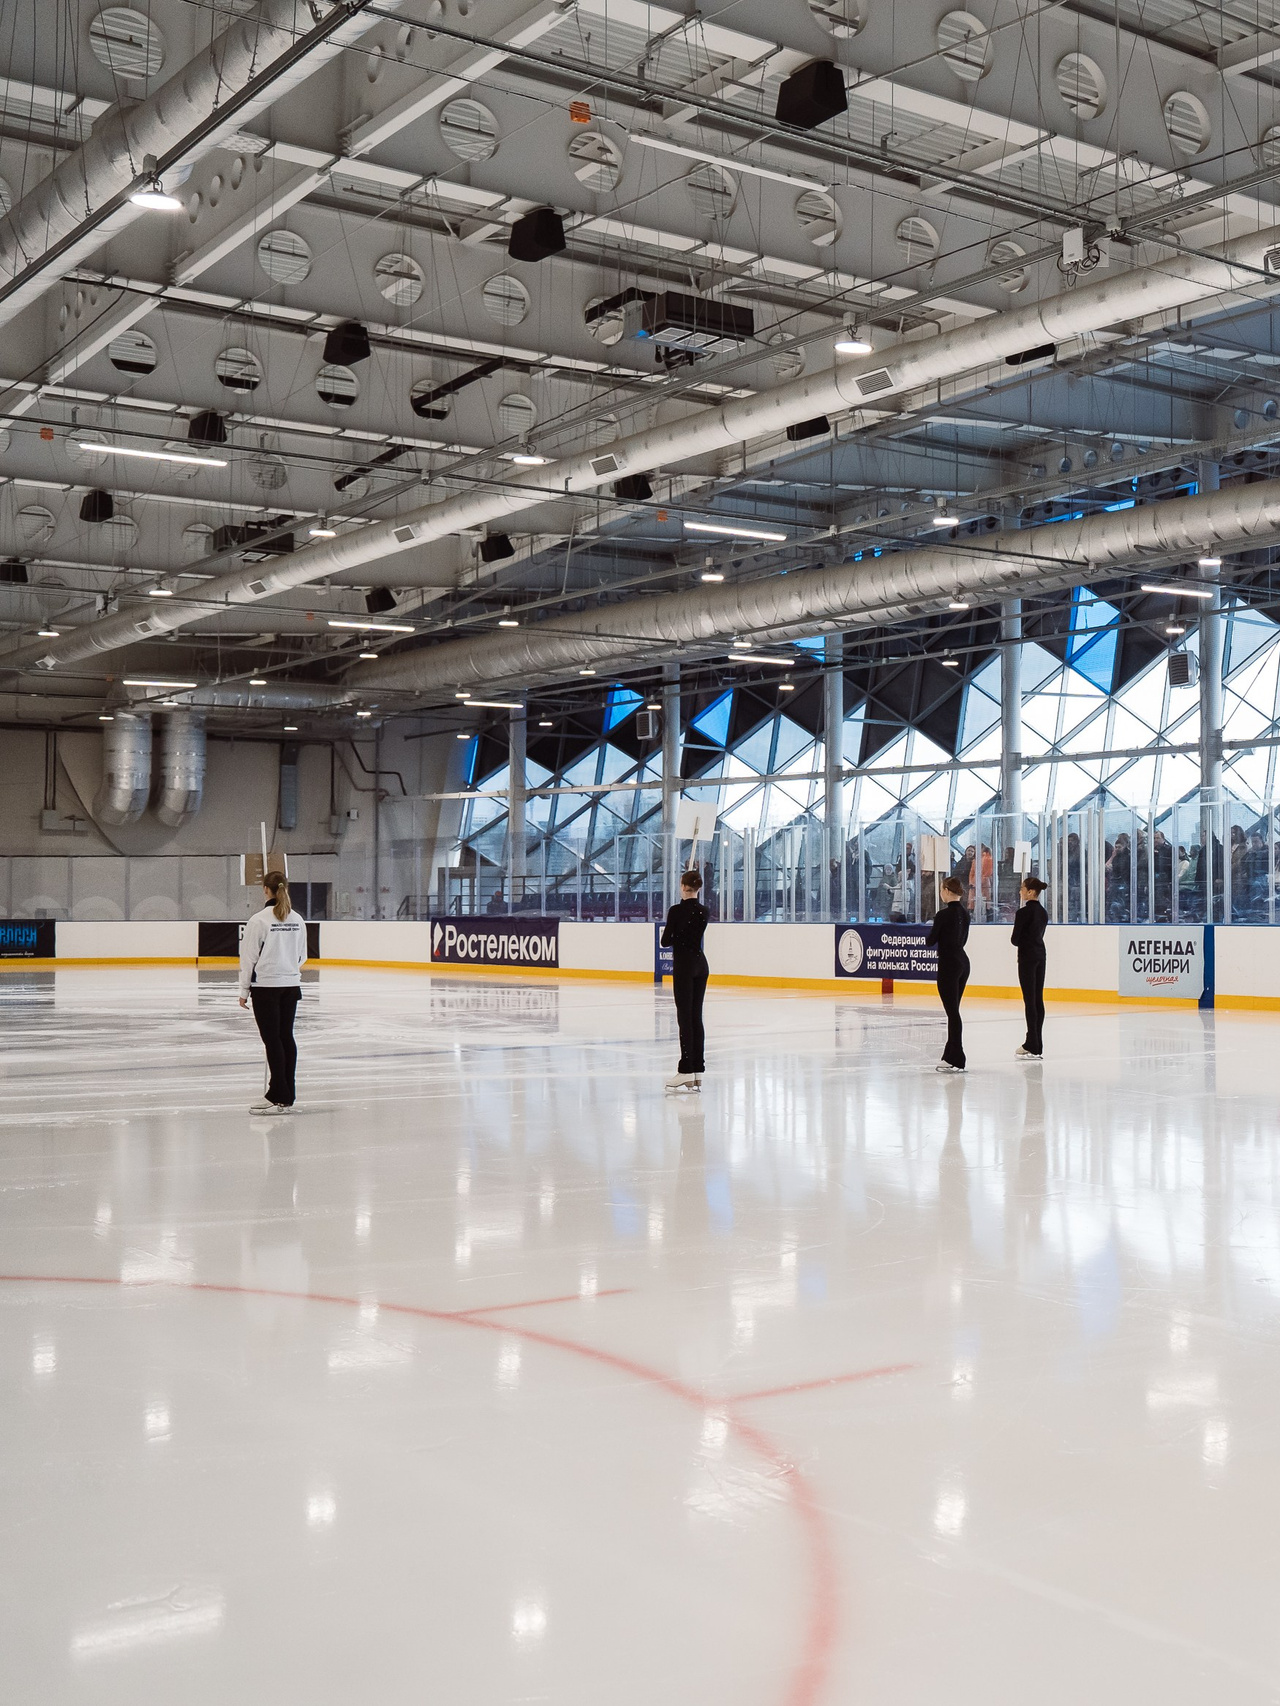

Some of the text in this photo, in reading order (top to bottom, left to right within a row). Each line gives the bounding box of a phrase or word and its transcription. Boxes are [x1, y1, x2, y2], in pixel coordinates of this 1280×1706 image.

[445, 924, 556, 962] Ростелеком
[881, 933, 926, 947] Федерация
[866, 946, 939, 960] фигурного катани
[867, 960, 877, 970] на
[878, 961, 909, 971] коньках
[1132, 957, 1190, 973] СИБИРИ
